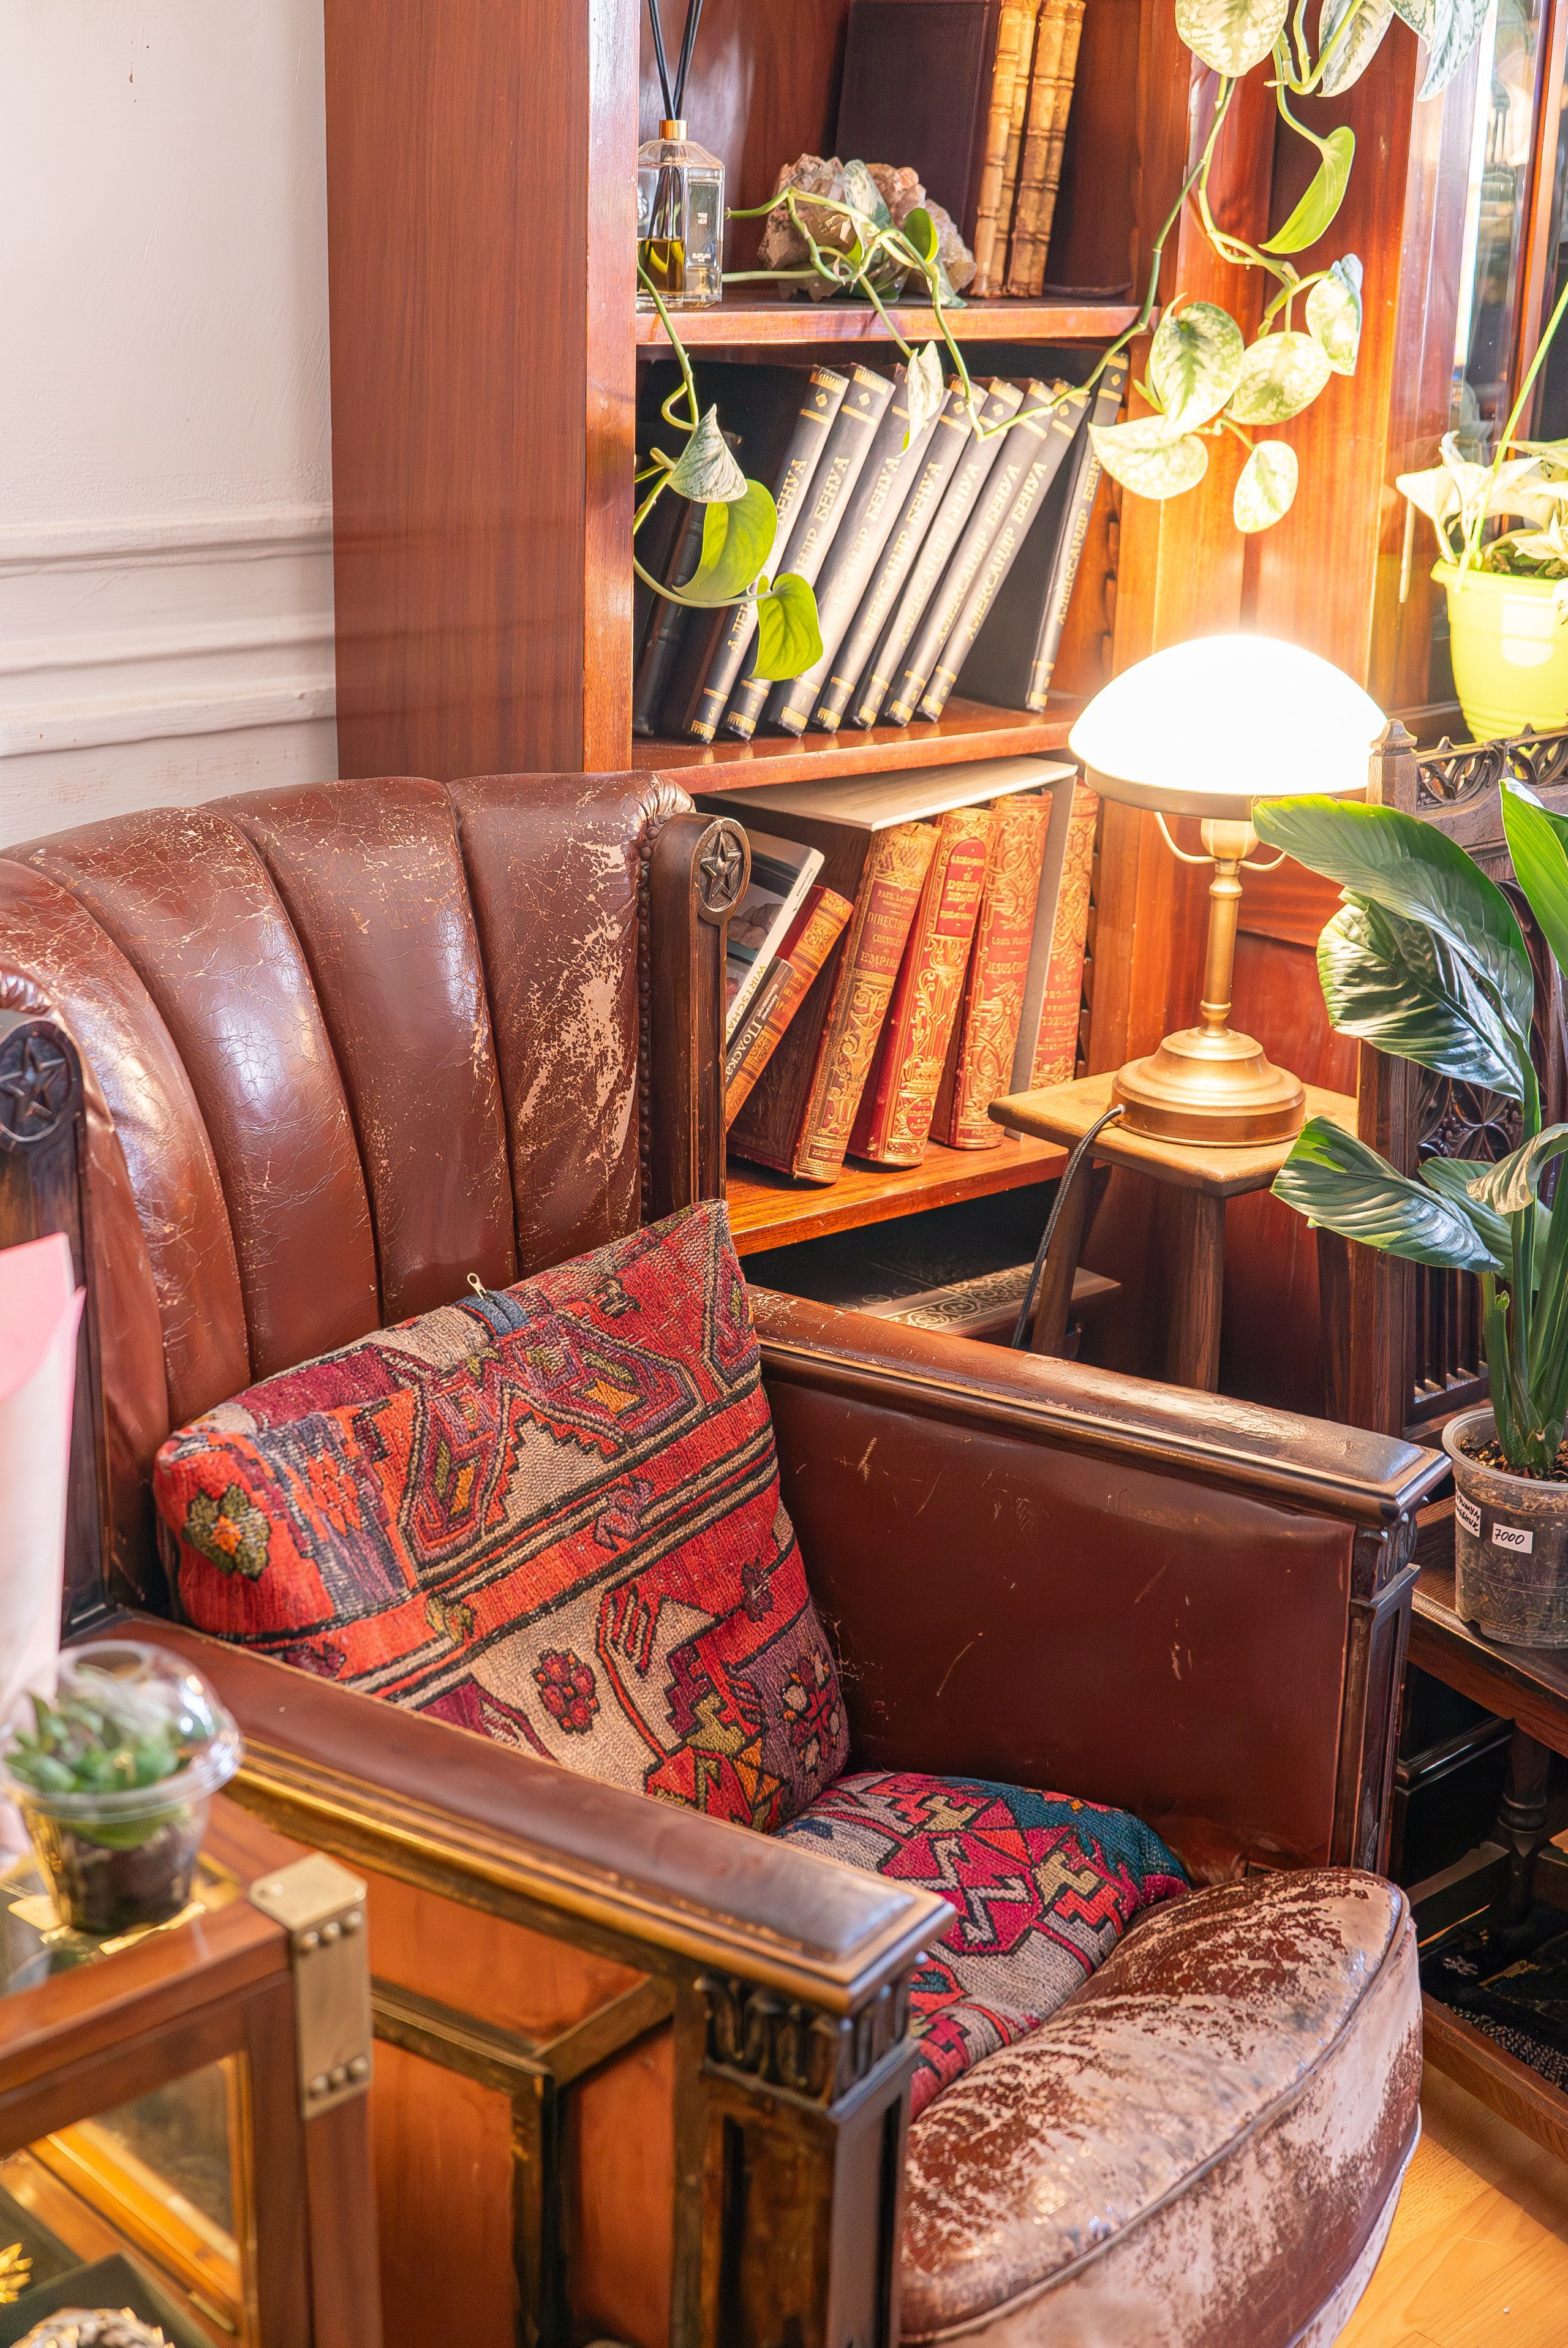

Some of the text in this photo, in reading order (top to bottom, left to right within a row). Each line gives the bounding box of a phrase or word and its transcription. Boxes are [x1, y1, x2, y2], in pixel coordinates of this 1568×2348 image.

[777, 459, 809, 526] БЕНУА
[813, 456, 851, 524] БЕНУА
[865, 456, 901, 521] БЕНУА
[859, 462, 944, 647] АЛЕКСАНДР БЕНУА
[900, 463, 980, 646] АЛЕКСАНДР БЕНУА
[937, 463, 1022, 644] АЛЕКСАНДР БЕНУА
[965, 462, 1048, 641] АЛЕКСАНДР БЕНУА
[1057, 453, 1101, 625] АЛЕКСАНДР БЕНУ
[708, 706, 717, 720] 3
[748, 700, 758, 712] 2
[837, 695, 846, 708] 7
[725, 1017, 764, 1083] Подска
[1494, 1528, 1525, 1545] 7000
